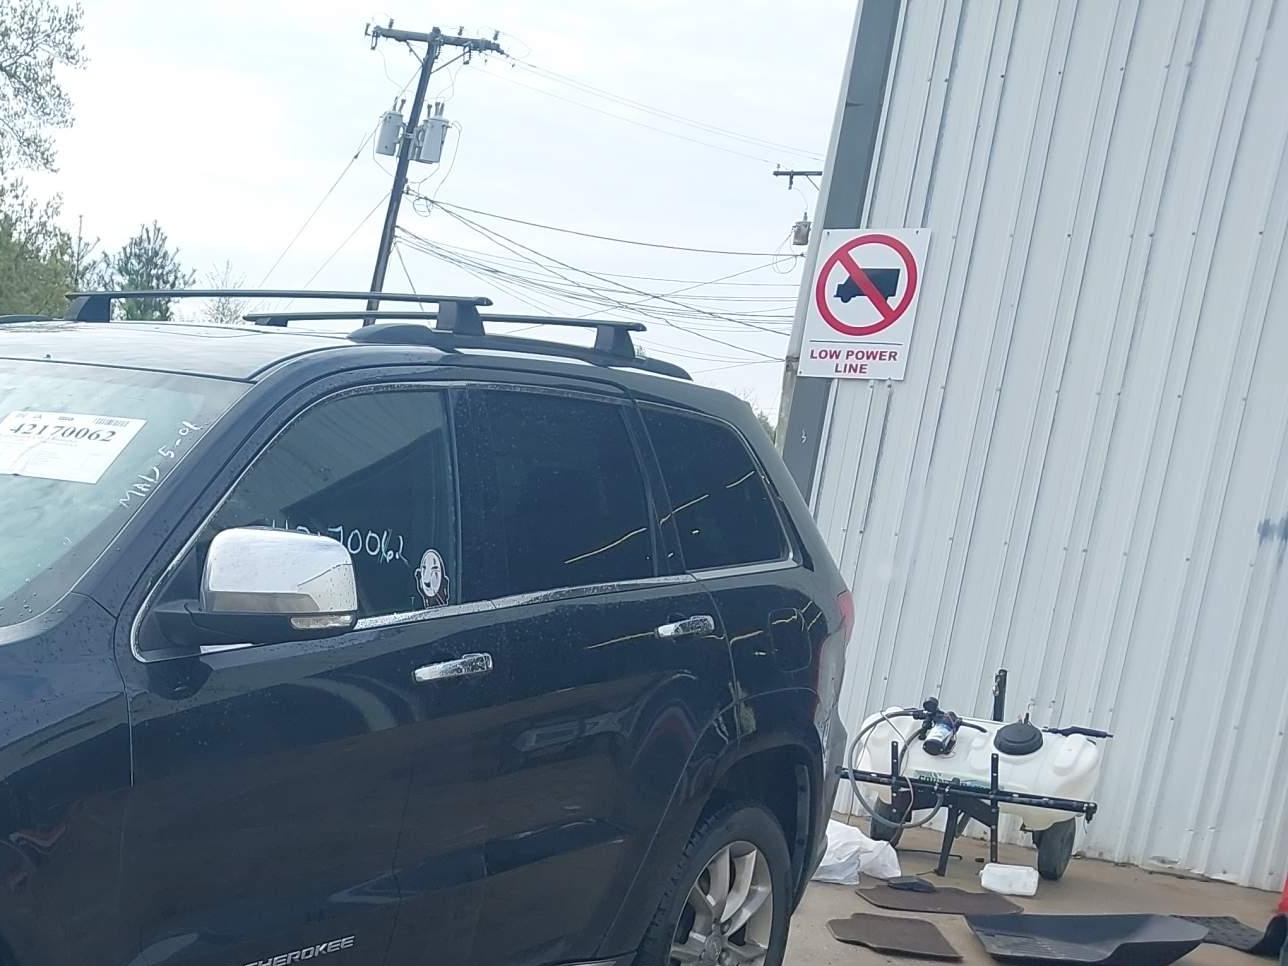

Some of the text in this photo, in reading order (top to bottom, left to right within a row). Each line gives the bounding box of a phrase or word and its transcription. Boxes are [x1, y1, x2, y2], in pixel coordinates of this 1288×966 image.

[810, 349, 898, 361] LOW POWER
[834, 363, 868, 374] LINE
[9, 422, 117, 442] 42170062
